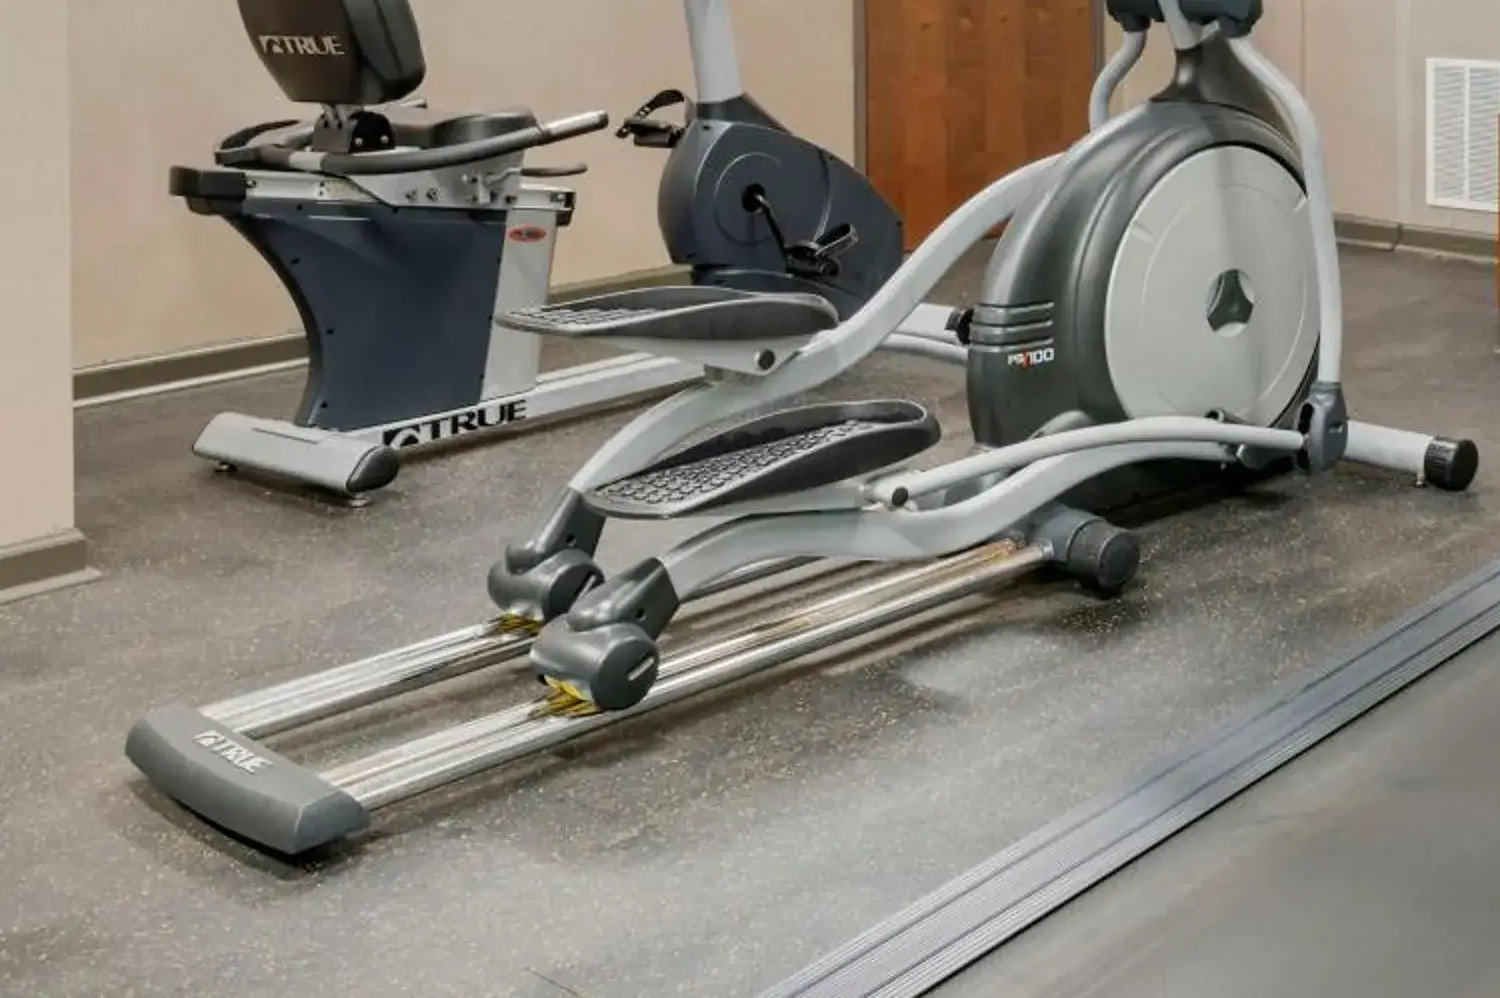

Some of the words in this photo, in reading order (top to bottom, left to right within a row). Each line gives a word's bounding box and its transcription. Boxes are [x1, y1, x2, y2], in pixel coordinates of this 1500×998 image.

[281, 34, 345, 56] TRUE
[419, 399, 526, 440] TRUE
[211, 738, 275, 774] TRUE
